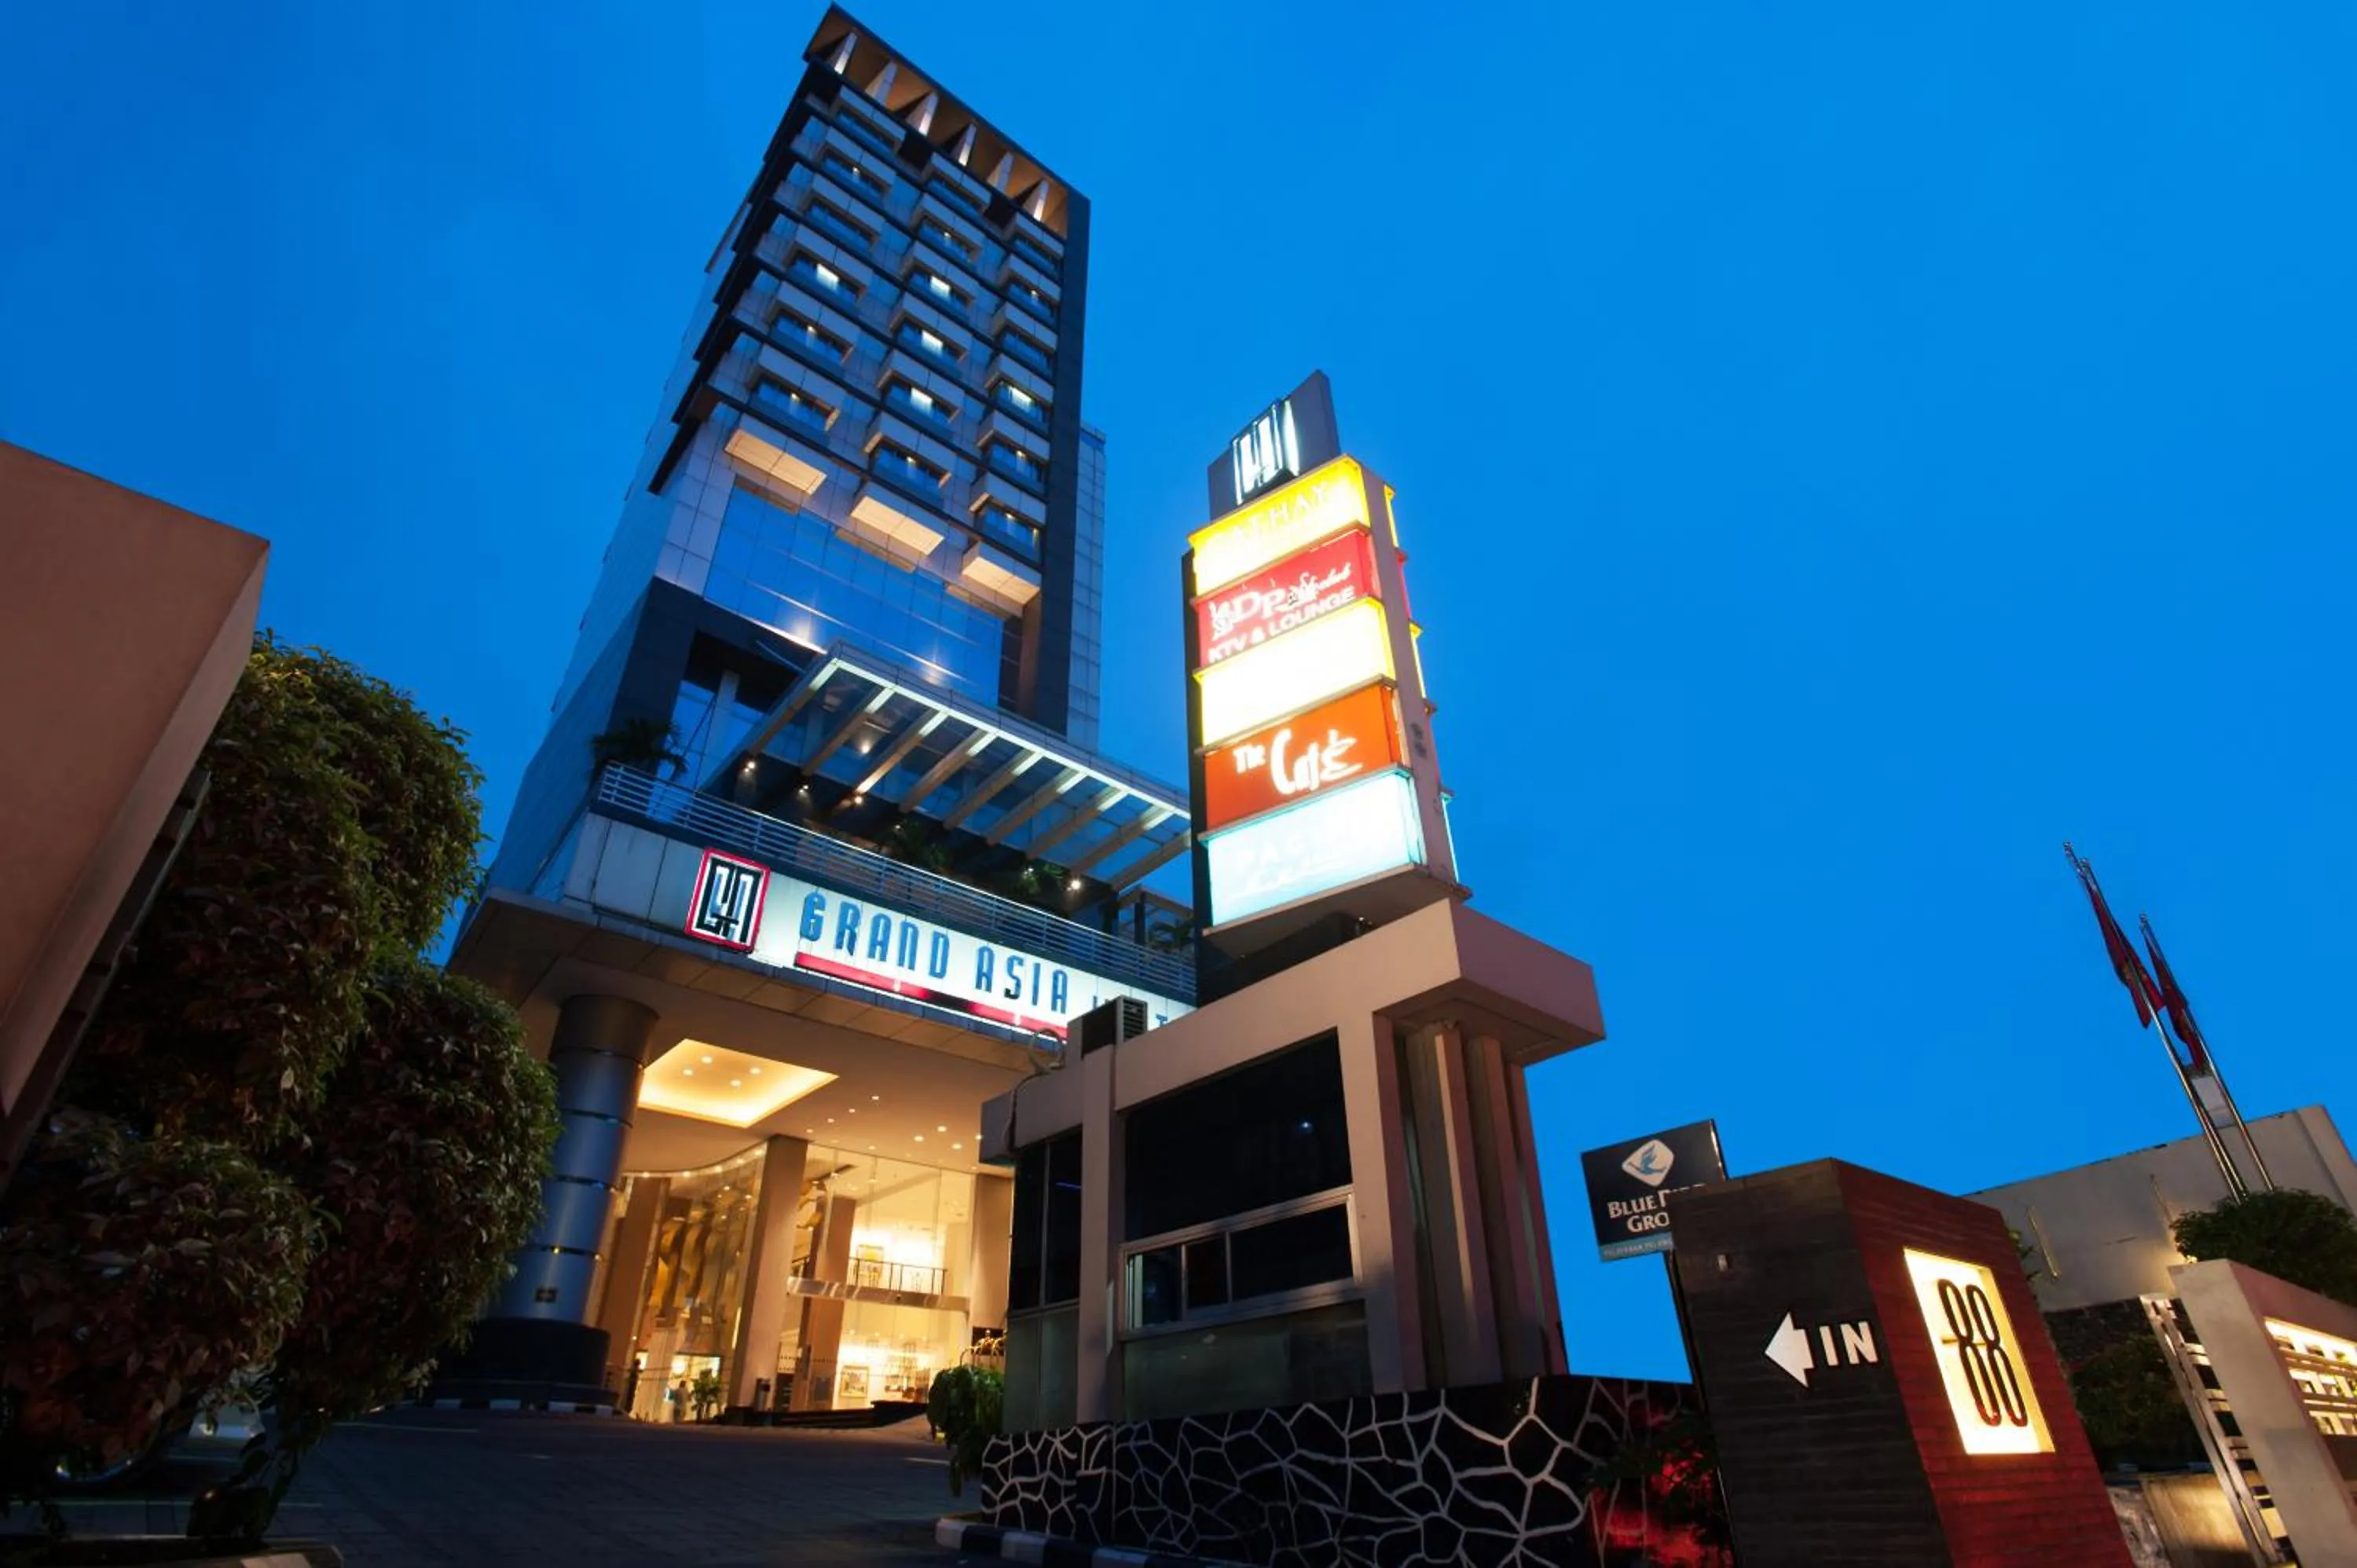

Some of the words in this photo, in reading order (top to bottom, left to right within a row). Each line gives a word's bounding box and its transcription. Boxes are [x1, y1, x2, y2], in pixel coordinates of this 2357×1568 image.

[1208, 632, 1248, 663] KTV
[1269, 585, 1356, 636] LOUNGE
[800, 890, 949, 980] GRAND
[975, 944, 1068, 1014] ASIA
[1607, 1194, 1657, 1218] BLUE
[1627, 1212, 1670, 1233] GRO
[1819, 1321, 1879, 1367] IN
